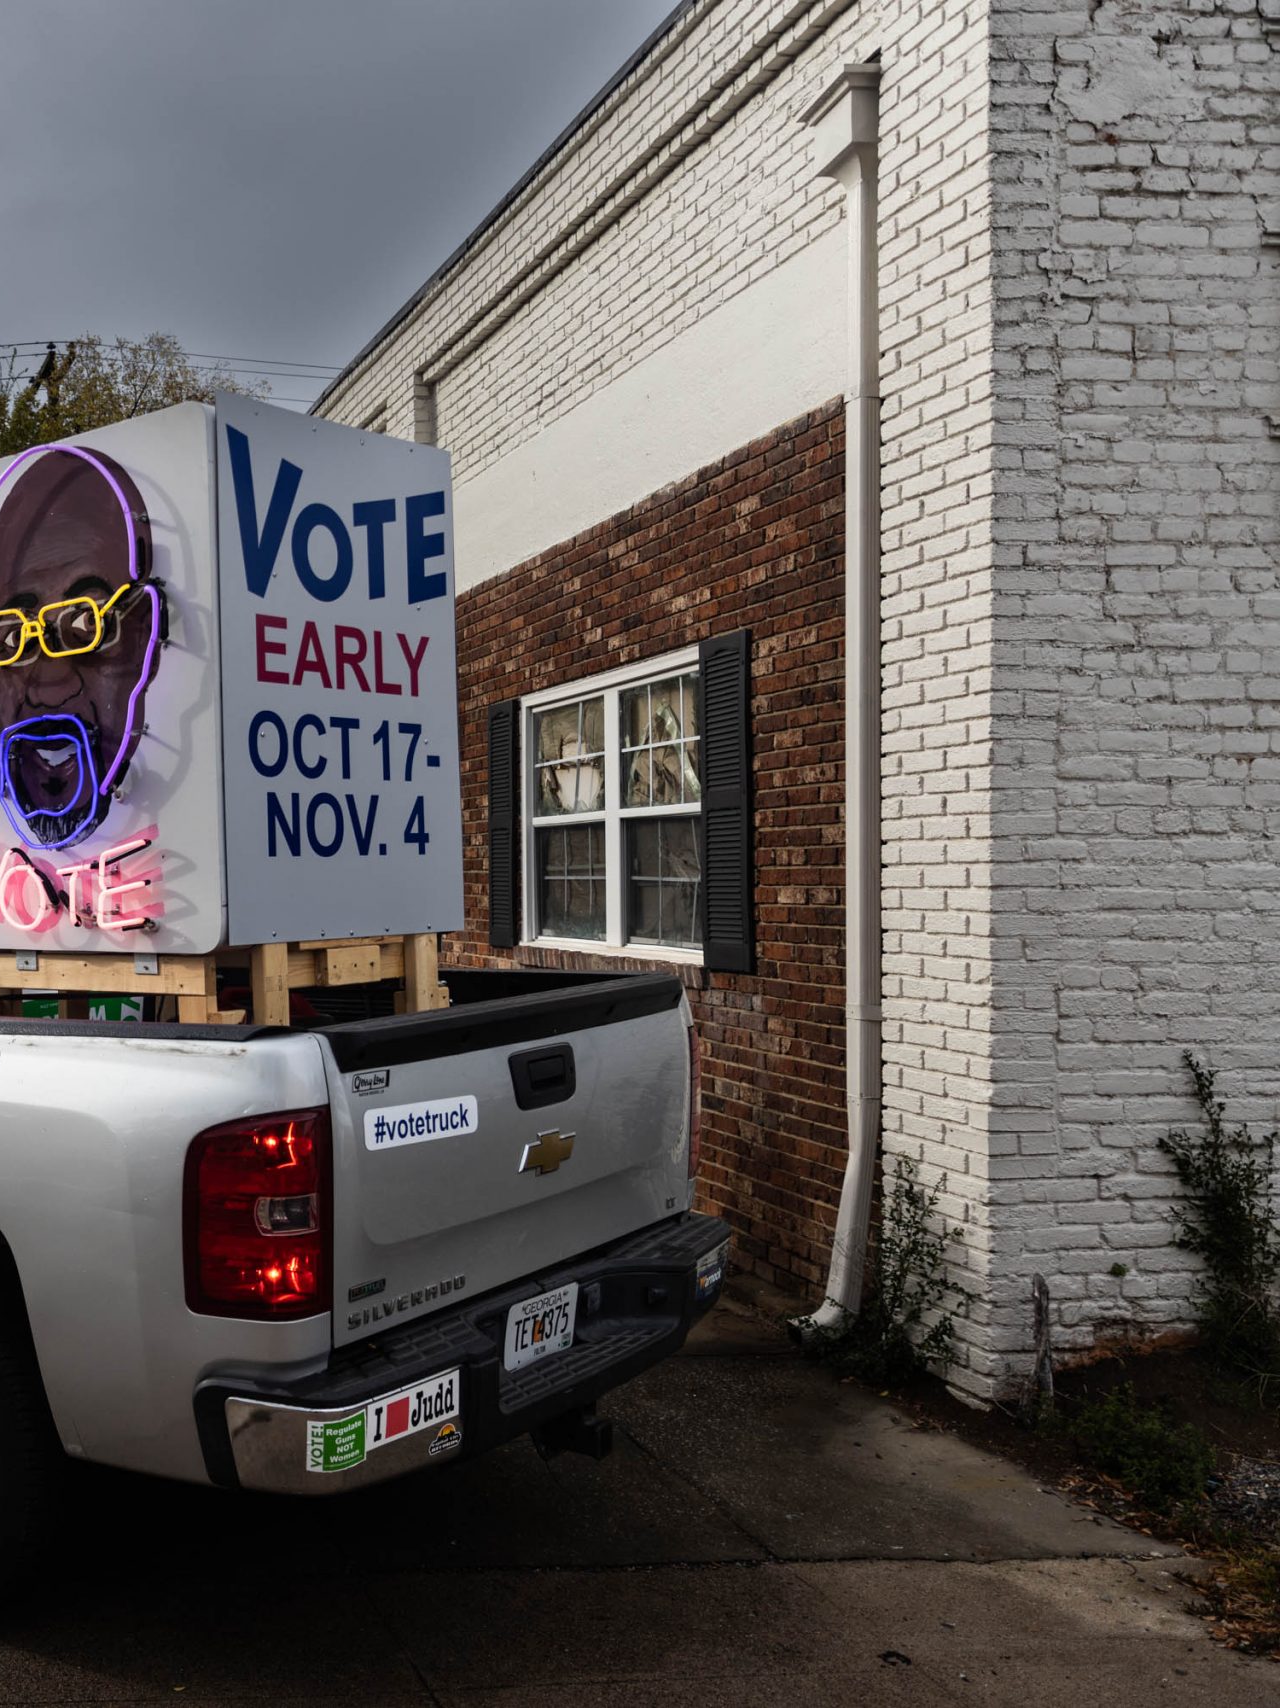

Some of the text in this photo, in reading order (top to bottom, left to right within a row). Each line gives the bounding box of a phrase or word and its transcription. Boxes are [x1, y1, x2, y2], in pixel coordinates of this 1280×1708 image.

[226, 424, 446, 604] VOTE
[255, 614, 429, 697] EARLY
[249, 711, 440, 782] OCT 17-
[268, 792, 429, 857] NOV. 4
[374, 1103, 469, 1144] #votetruck
[347, 1274, 466, 1330] SILVERADO
[524, 1292, 563, 1315] GEORGIA
[326, 1420, 362, 1436] Regulate
[374, 1379, 454, 1442] I Judd
[311, 1426, 323, 1468] VOTE!
[330, 1450, 360, 1463] Women
[335, 1433, 356, 1445] Guns
[337, 1442, 354, 1453] NOT
